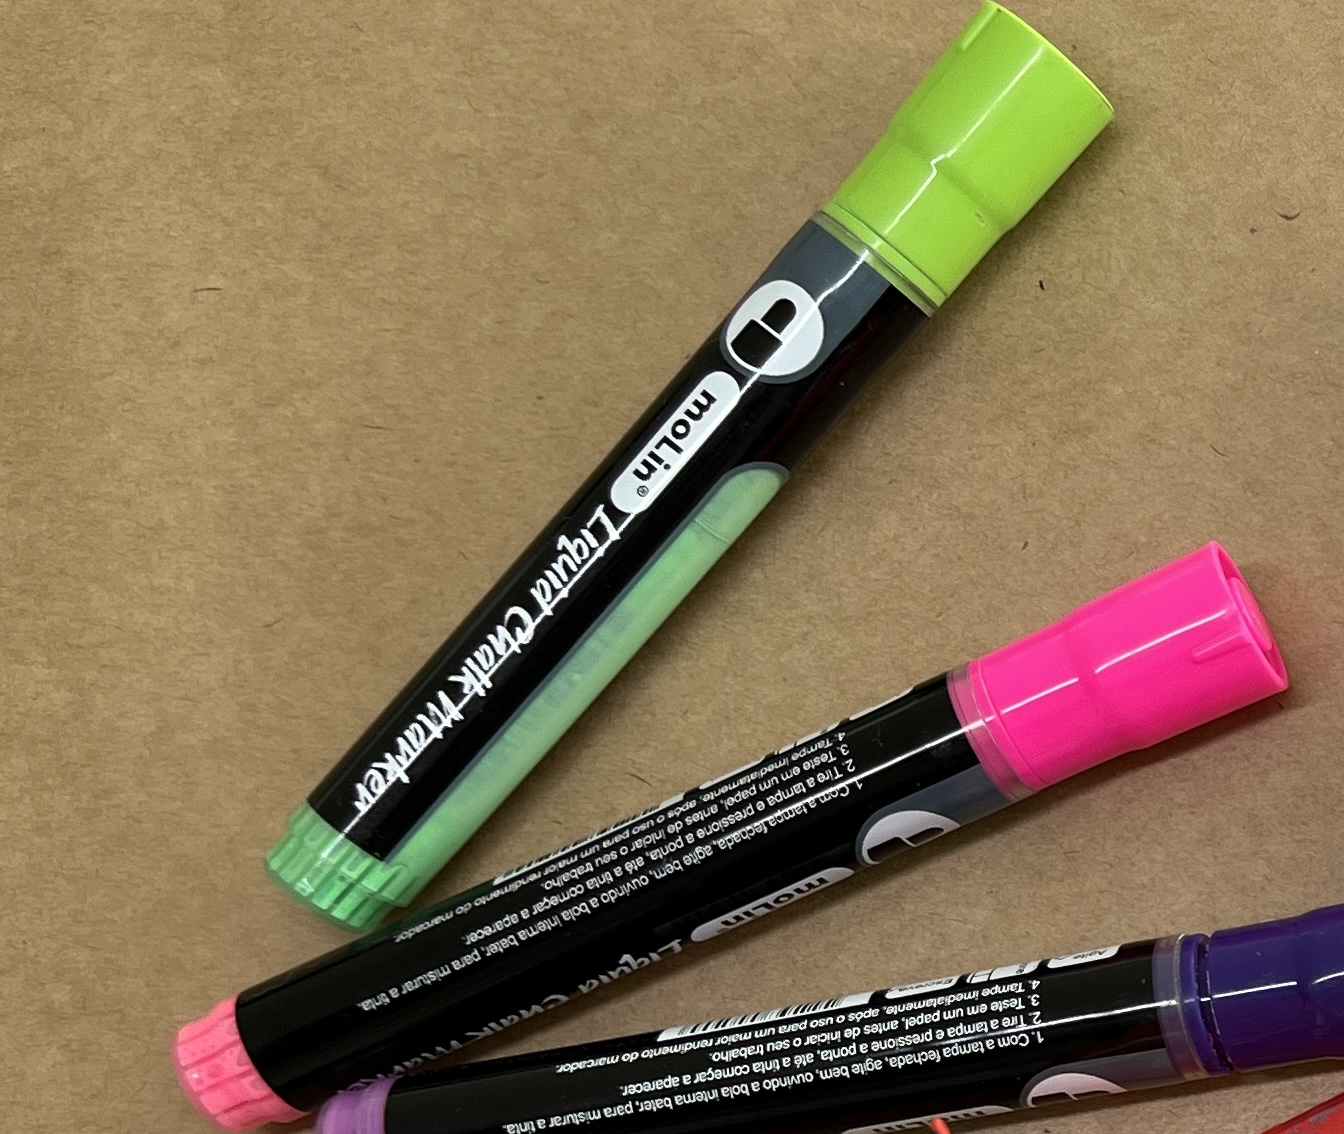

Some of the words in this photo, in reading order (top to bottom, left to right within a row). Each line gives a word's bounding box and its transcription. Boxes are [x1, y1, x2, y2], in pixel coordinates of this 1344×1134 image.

[529, 504, 621, 616] Liquid
[447, 605, 535, 697] Chalk
[353, 689, 464, 815] Marker
[816, 766, 843, 782] Tire
[766, 782, 806, 805] tampa
[696, 803, 754, 838] pressione
[645, 835, 684, 860] ponta,
[624, 856, 644, 873] até
[585, 871, 613, 889] tinta
[532, 884, 584, 914] começar
[462, 913, 518, 944] aparecer.
[981, 982, 1024, 996] Tampe
[883, 990, 978, 1014] imediatamente,
[990, 997, 1025, 1011] Teste
[809, 1016, 833, 1028] uso
[847, 1008, 879, 1022] após
[901, 1009, 940, 1029] papel,
[1001, 1014, 1027, 1030] Tire
[778, 1019, 807, 1033] para
[863, 1019, 898, 1034] antes
[946, 1021, 988, 1040] tampa
[714, 1031, 751, 1045] maior
[766, 1039, 790, 1051] seu
[804, 1030, 840, 1045] iniciar
[871, 1029, 932, 1051] pressione
[996, 1028, 1029, 1047] Com
[641, 1038, 713, 1058] rendimento
[709, 1044, 763, 1061] trabalho.
[816, 1042, 856, 1061] ponta,
[942, 1036, 984, 1057] tampa
[556, 1055, 619, 1072] marcador.
[793, 1052, 814, 1068] até
[884, 1044, 940, 1068] fechada,
[694, 1064, 749, 1083] começar
[752, 1058, 780, 1073] tinta
[815, 1065, 849, 1079] bem,
[851, 1057, 882, 1074] agite
[620, 1076, 679, 1095] aparecer.
[762, 1072, 813, 1090] ouvindo
[674, 1089, 718, 1105] interna
[720, 1083, 749, 1098] bola
[603, 1100, 633, 1117] para
[635, 1097, 672, 1111] bater,
[549, 1109, 601, 1127] misturar
[502, 1120, 535, 1134] tinta.
